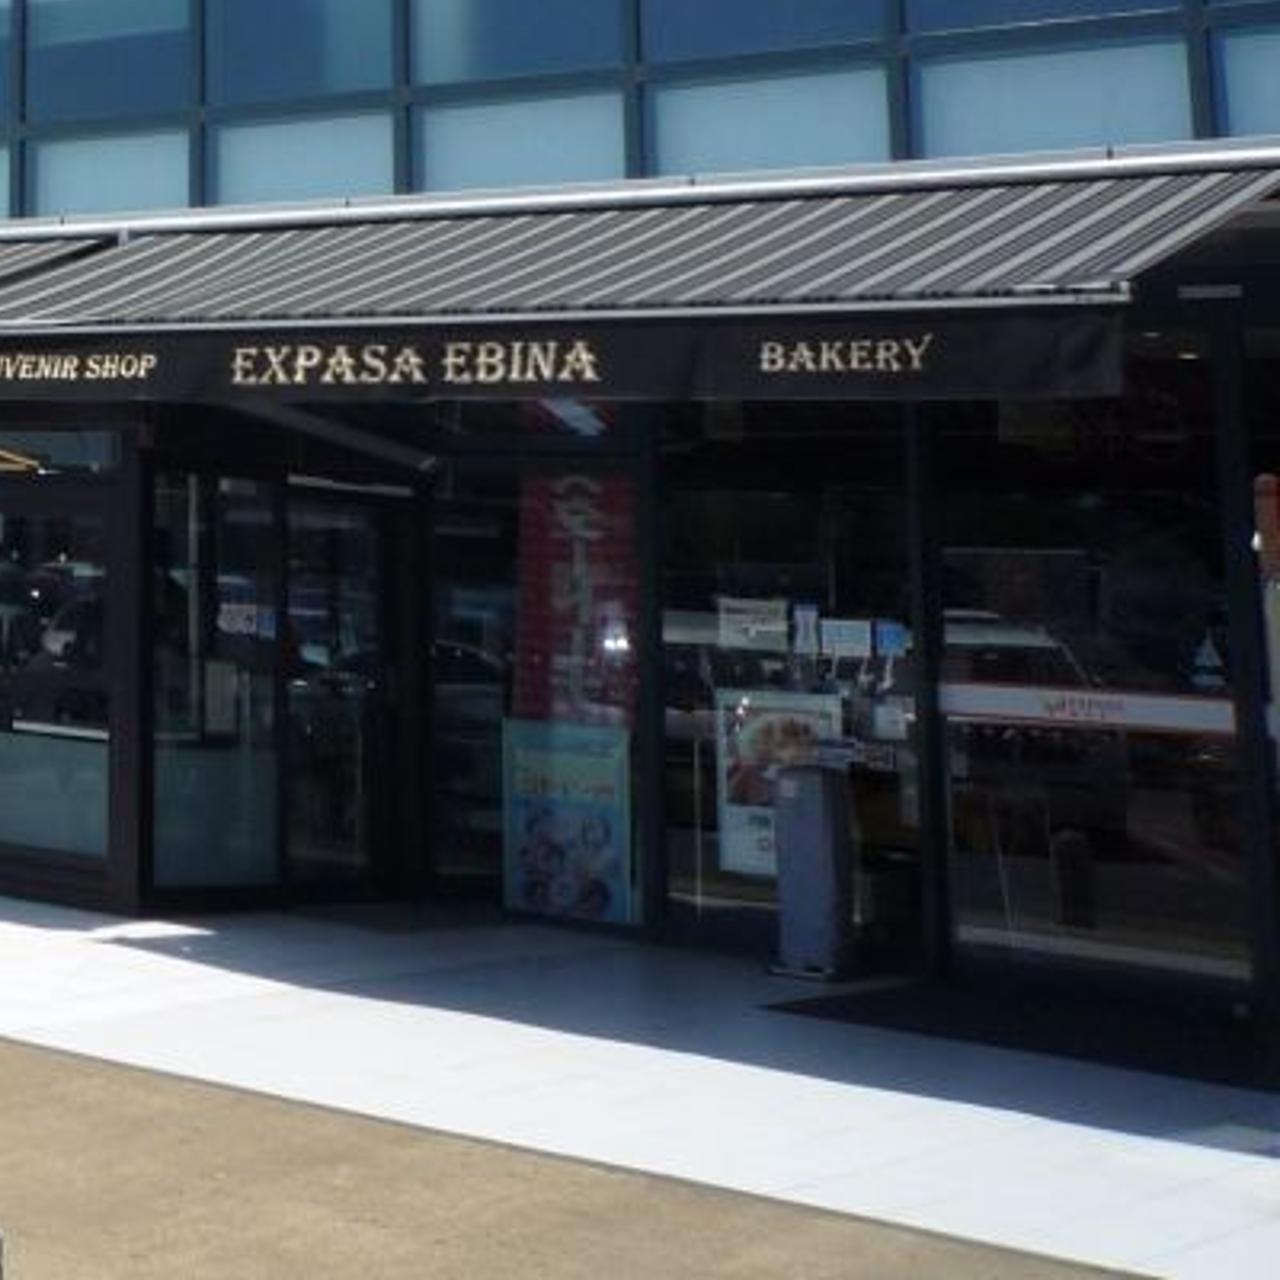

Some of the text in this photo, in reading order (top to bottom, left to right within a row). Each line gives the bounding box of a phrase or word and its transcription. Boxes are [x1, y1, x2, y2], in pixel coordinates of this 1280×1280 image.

[84, 354, 158, 380] SHOP
[231, 341, 601, 385] EXPASA EBINA
[759, 334, 932, 373] BAKERY
